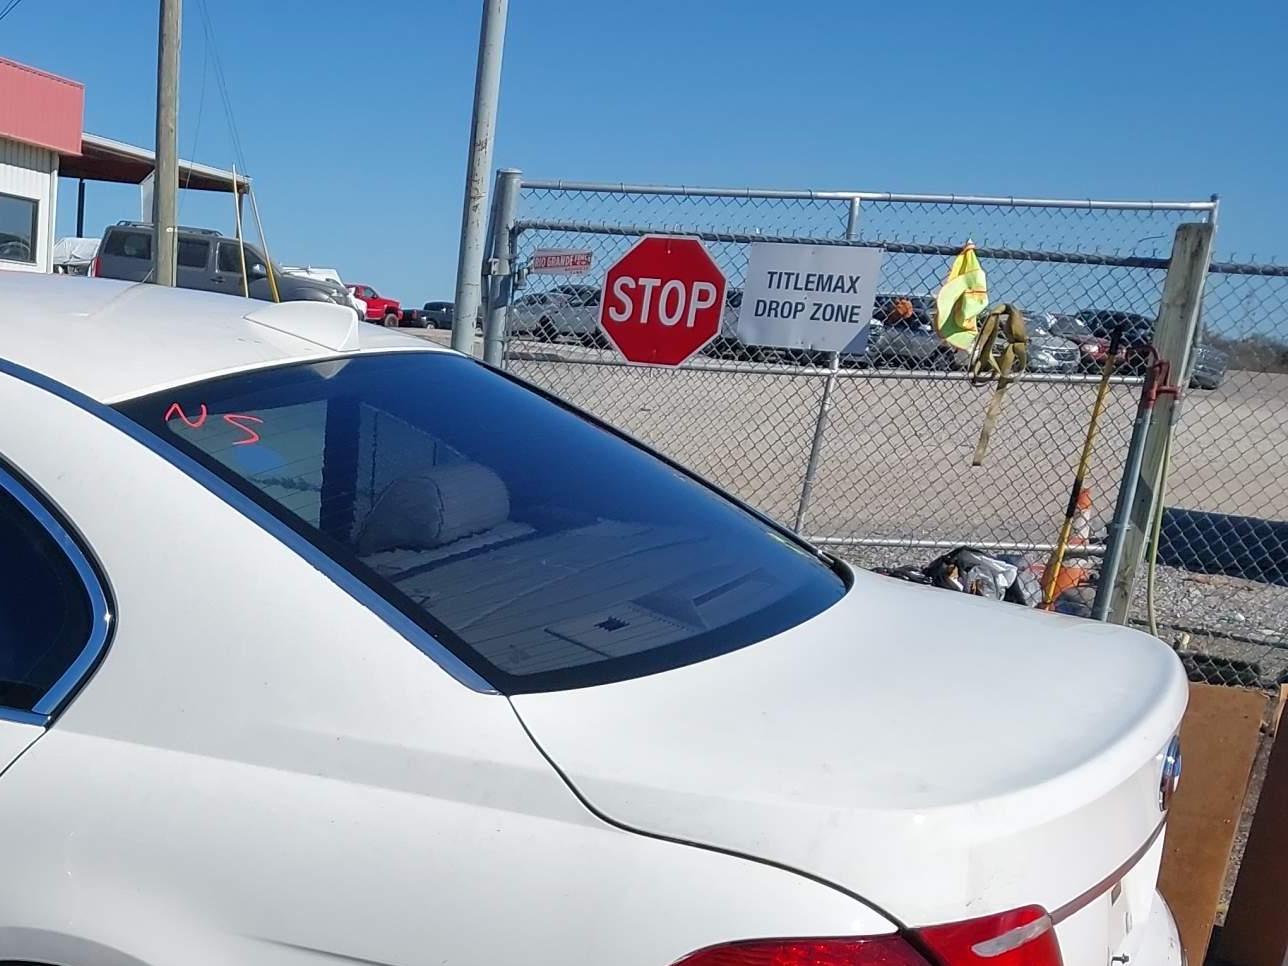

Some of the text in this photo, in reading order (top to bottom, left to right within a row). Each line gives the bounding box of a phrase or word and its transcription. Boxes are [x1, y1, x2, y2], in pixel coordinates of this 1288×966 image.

[767, 271, 861, 294] TITLEMAX
[609, 276, 717, 328] STOP
[754, 299, 861, 324] DROP ZONE
